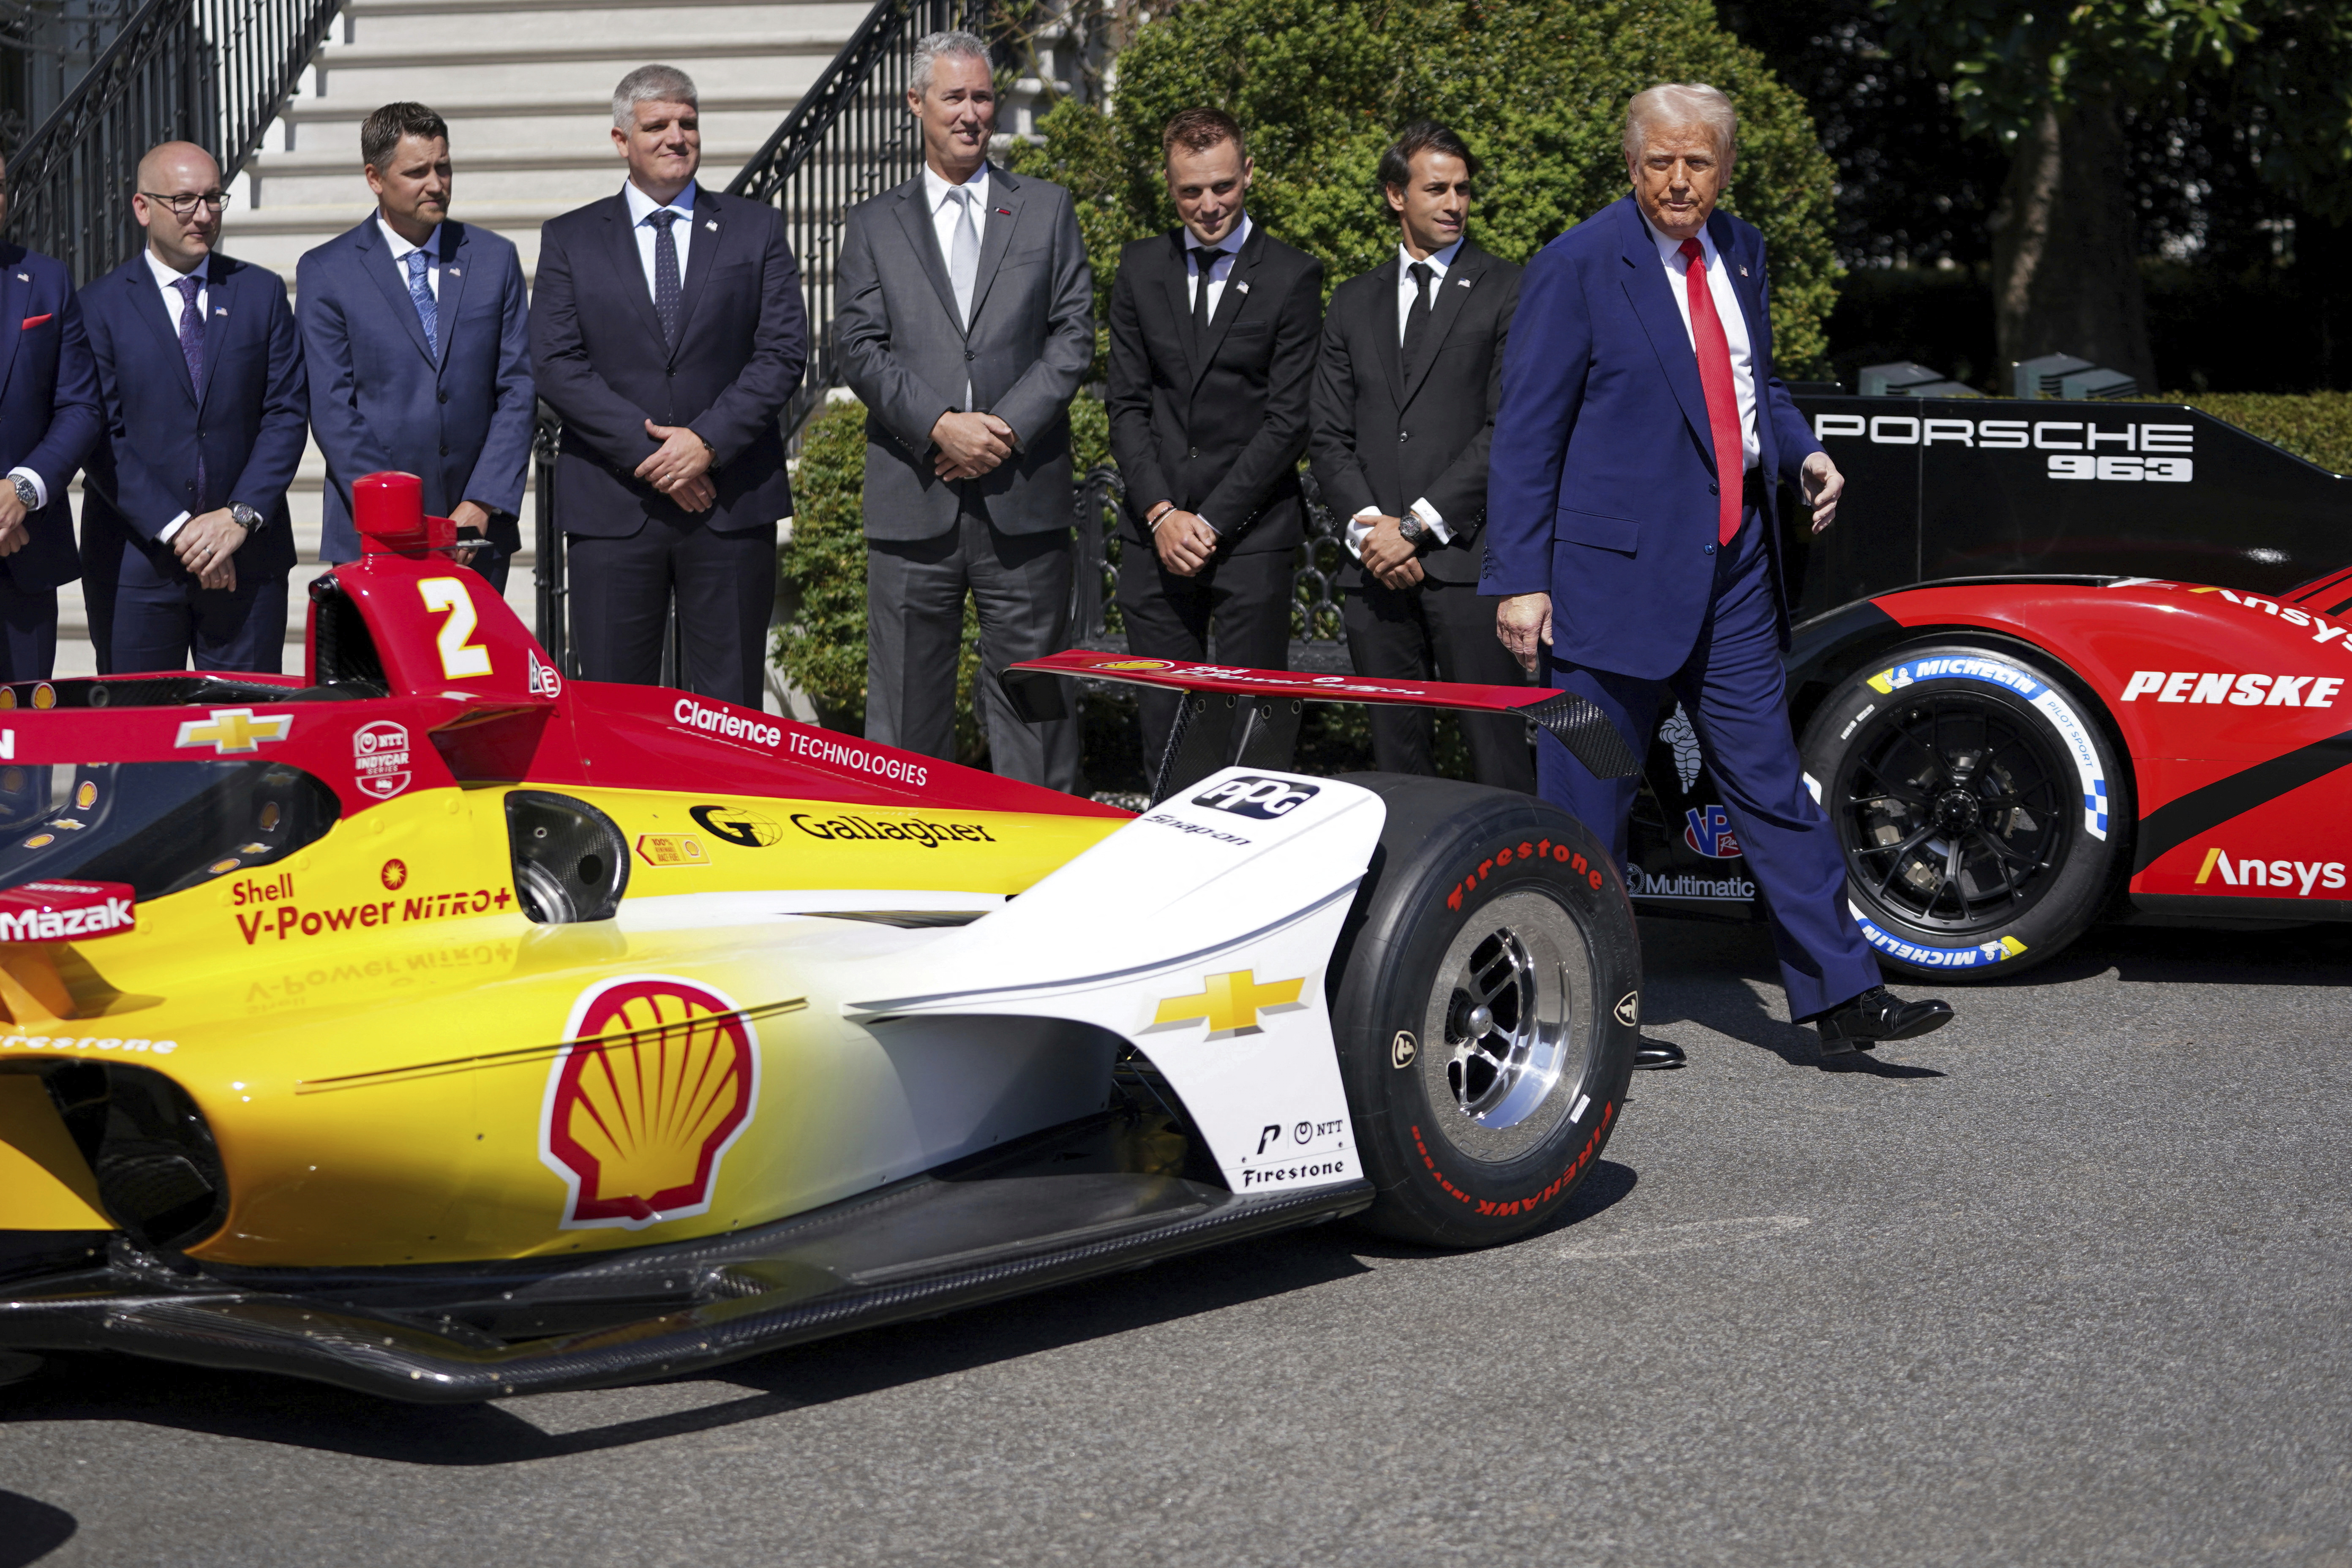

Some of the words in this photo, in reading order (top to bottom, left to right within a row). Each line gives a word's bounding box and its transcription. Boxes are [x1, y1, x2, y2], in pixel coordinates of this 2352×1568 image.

[1815, 414, 2194, 452] PORSCHE
[2048, 455, 2193, 482] 963
[417, 577, 493, 680] 2
[1916, 659, 2036, 693] MICHELIN
[2120, 671, 2345, 708] PENSKE
[378, 732, 403, 748] NTT
[673, 698, 781, 747] Clarience
[789, 732, 927, 786] TECHNOLOGIES
[2047, 700, 2074, 732] PILOT
[2070, 730, 2094, 769] SPORT
[355, 752, 410, 770] INDYCAR
[367, 765, 398, 775] SERIES
[1202, 779, 1311, 815] PPG
[790, 813, 997, 848] Gallagher
[1143, 815, 1251, 845] Snap-on
[232, 873, 294, 906] Shell
[1447, 838, 1603, 912] Firestone
[1646, 874, 1755, 897] Multimatic
[2195, 848, 2346, 896] Ansys
[0, 897, 135, 941] Mazak
[235, 900, 395, 945] V-Power
[1862, 925, 1977, 966] MICHELIN
[0, 1034, 177, 1054] restone
[1317, 1120, 1343, 1136] NTT
[1243, 1161, 1344, 1187] Firestone
[1474, 1100, 1613, 1216] FIREHAWK
